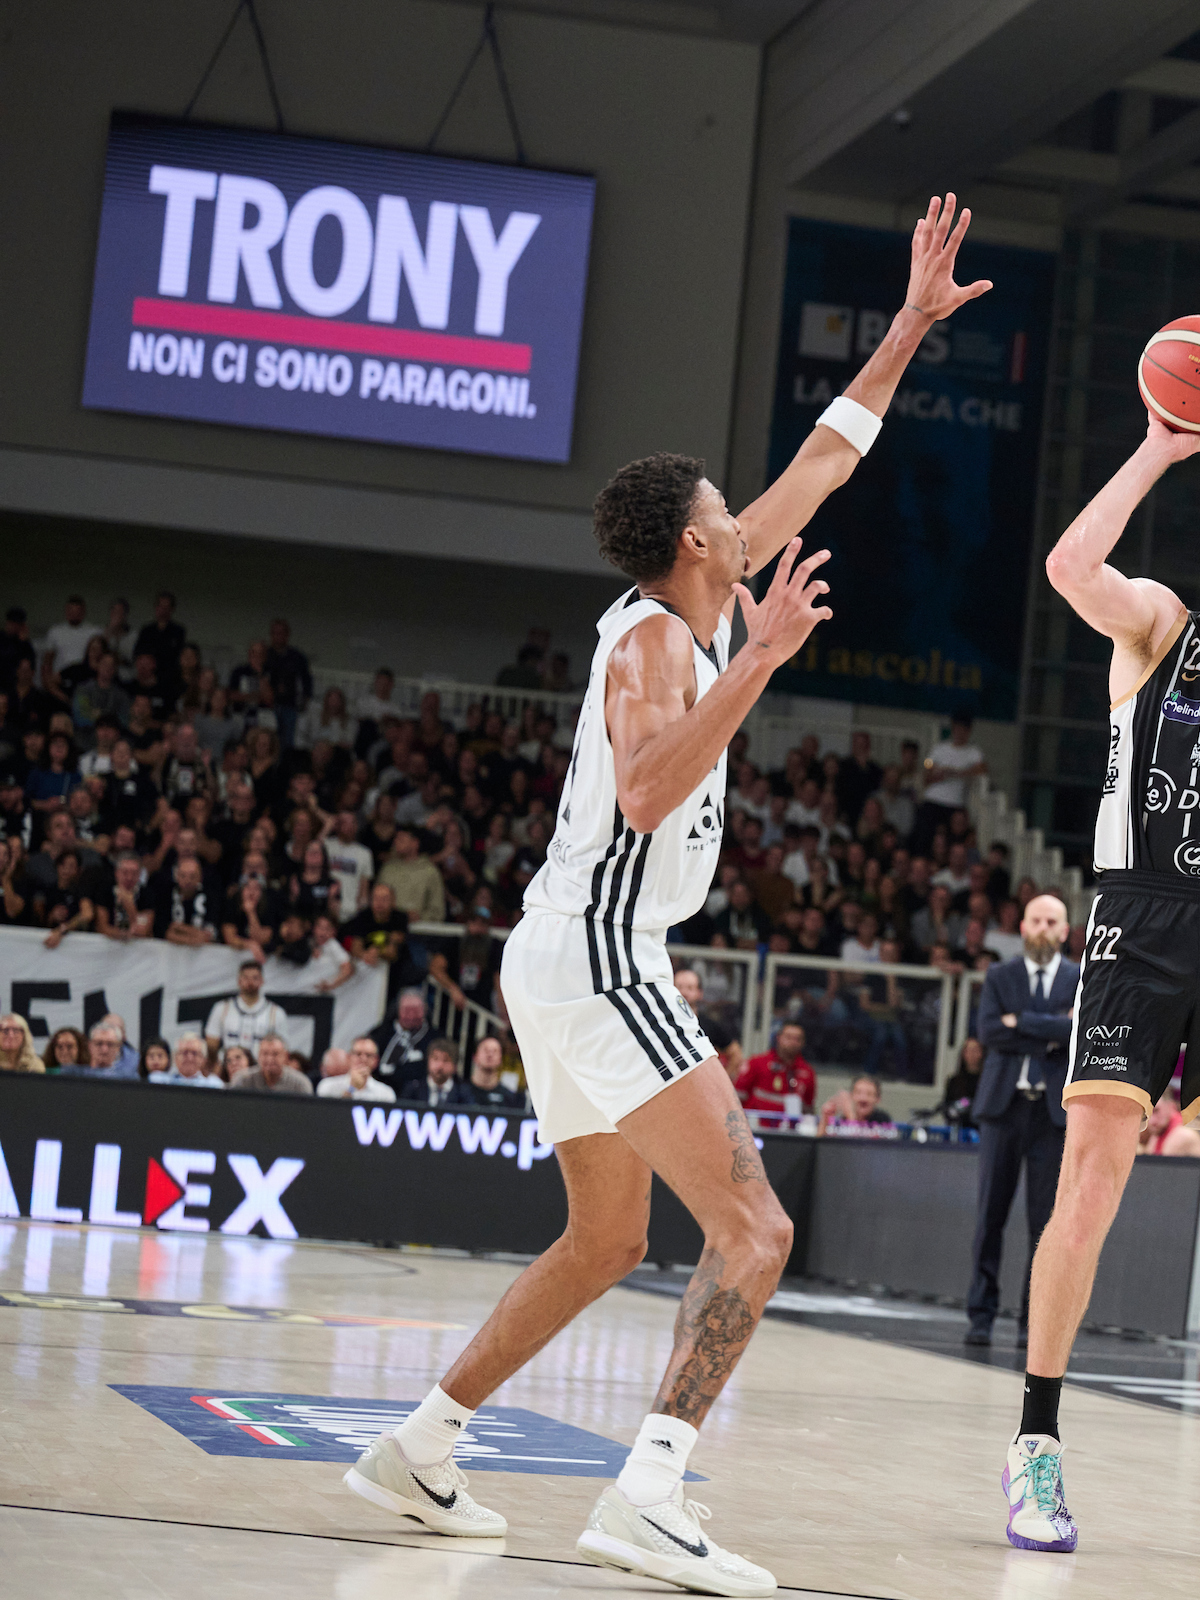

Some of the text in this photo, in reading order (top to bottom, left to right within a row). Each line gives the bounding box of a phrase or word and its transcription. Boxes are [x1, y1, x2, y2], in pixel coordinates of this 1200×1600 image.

[149, 165, 541, 336] TRONY
[856, 308, 952, 364] BS
[128, 331, 537, 419] NON CI SONO PARAGONI.
[959, 398, 1025, 432] CHE
[828, 648, 983, 691] ascolta
[686, 844, 704, 852] THE
[1090, 924, 1122, 961] 22
[1085, 1025, 1133, 1040] CAVIT
